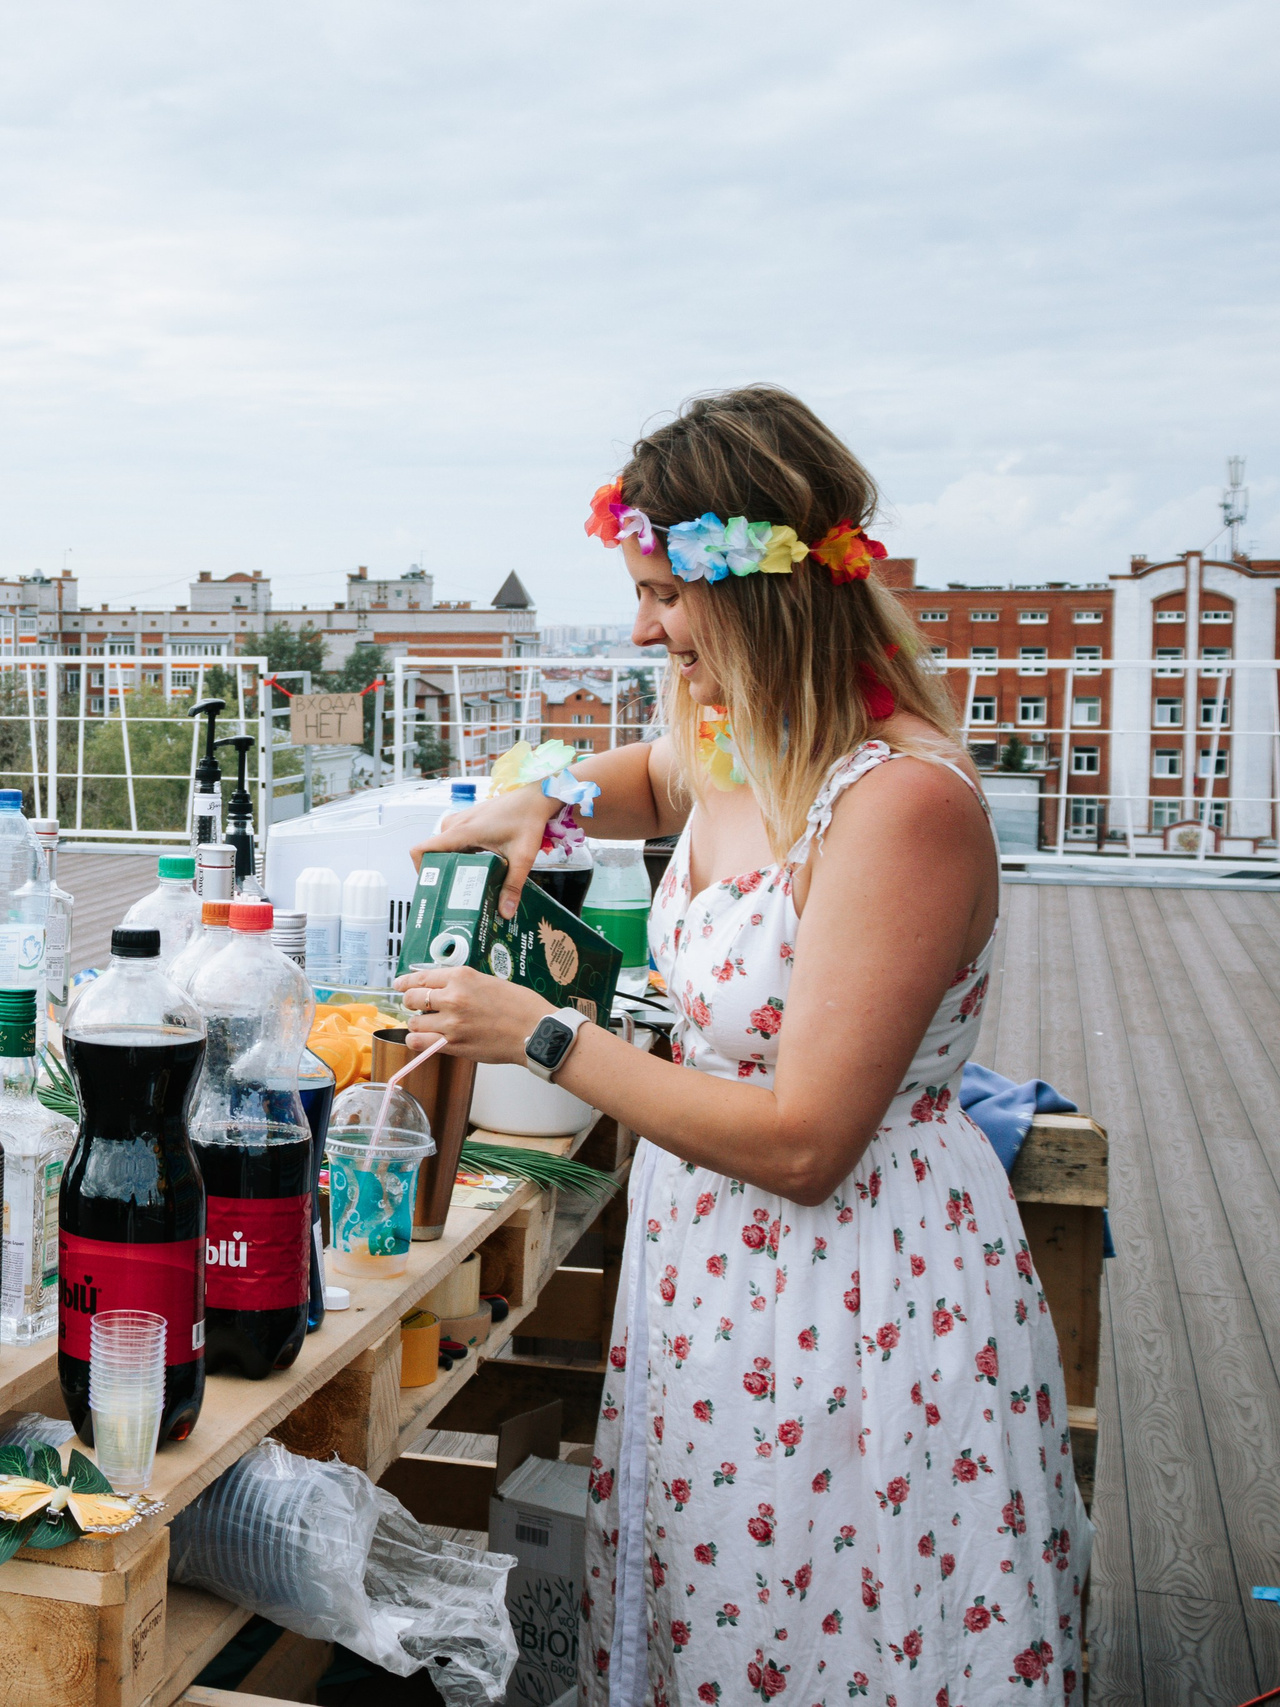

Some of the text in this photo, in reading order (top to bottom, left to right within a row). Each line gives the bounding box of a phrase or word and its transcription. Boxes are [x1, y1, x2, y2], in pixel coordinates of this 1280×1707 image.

[295, 695, 358, 713] ВХОДА
[304, 712, 348, 739] НЕТ
[415, 898, 428, 929] ананас
[527, 930, 535, 950] СИЛ
[519, 932, 528, 977] БОЛЬШЕ
